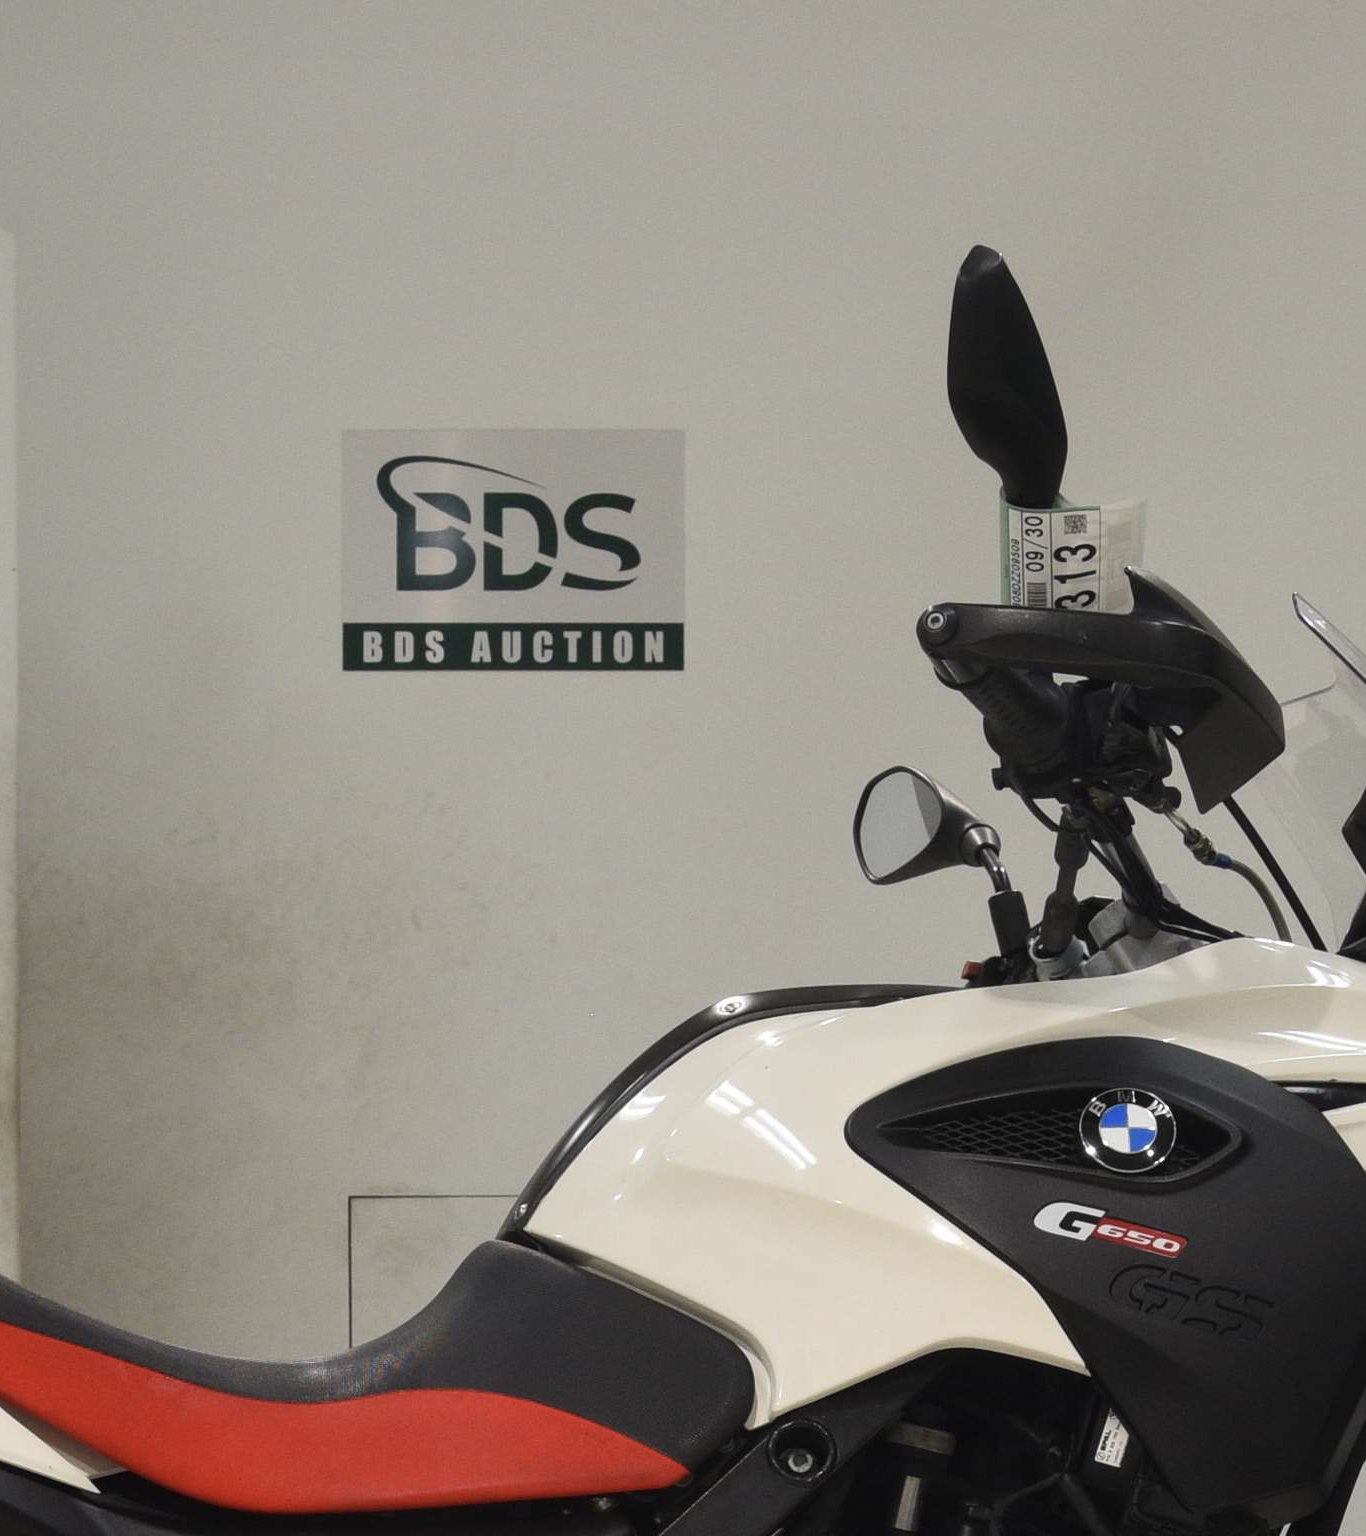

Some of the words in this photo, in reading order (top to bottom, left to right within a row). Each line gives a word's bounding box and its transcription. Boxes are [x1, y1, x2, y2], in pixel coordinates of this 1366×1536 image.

[377, 456, 641, 591] BDS
[1024, 515, 1049, 572] 09/30
[362, 630, 446, 663] BDS
[470, 630, 664, 663] AUCTION
[1088, 1089, 1172, 1118] BMW
[1108, 1263, 1275, 1336] GS
